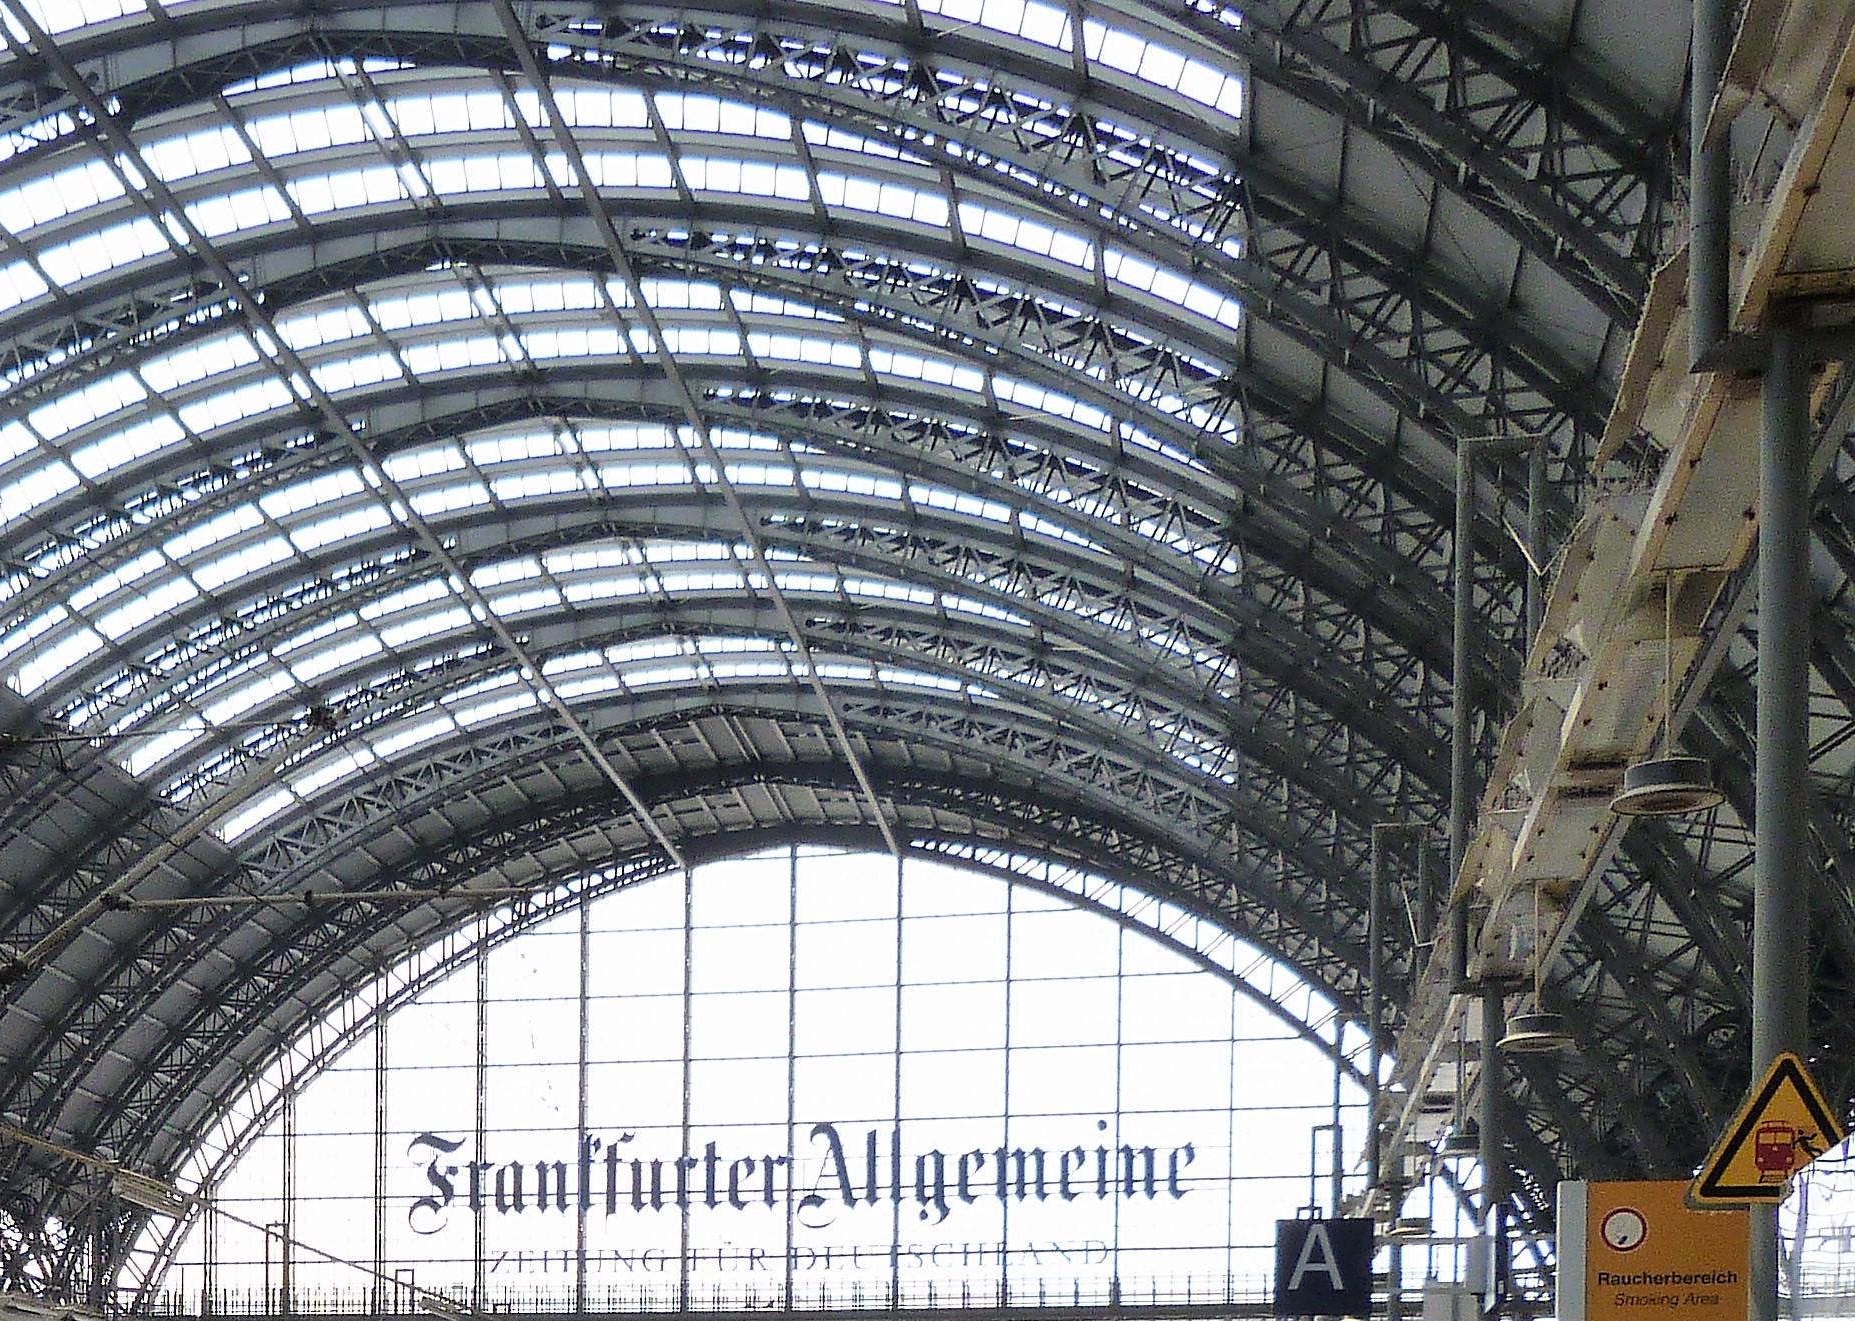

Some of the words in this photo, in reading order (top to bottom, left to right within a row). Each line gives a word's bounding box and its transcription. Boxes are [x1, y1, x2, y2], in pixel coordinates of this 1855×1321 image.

[407, 1132, 790, 1234] Frankfurter
[797, 1120, 1196, 1229] Allgemeine
[490, 1248, 668, 1273] ZEITUNG
[689, 1242, 768, 1272] FÜR
[791, 1239, 1109, 1271] DEUTSCHLAND
[1287, 1223, 1345, 1290] A
[1597, 1270, 1738, 1286] Raucherbereich
[1614, 1292, 1679, 1309] Smoking
[1683, 1292, 1720, 1306] Area
